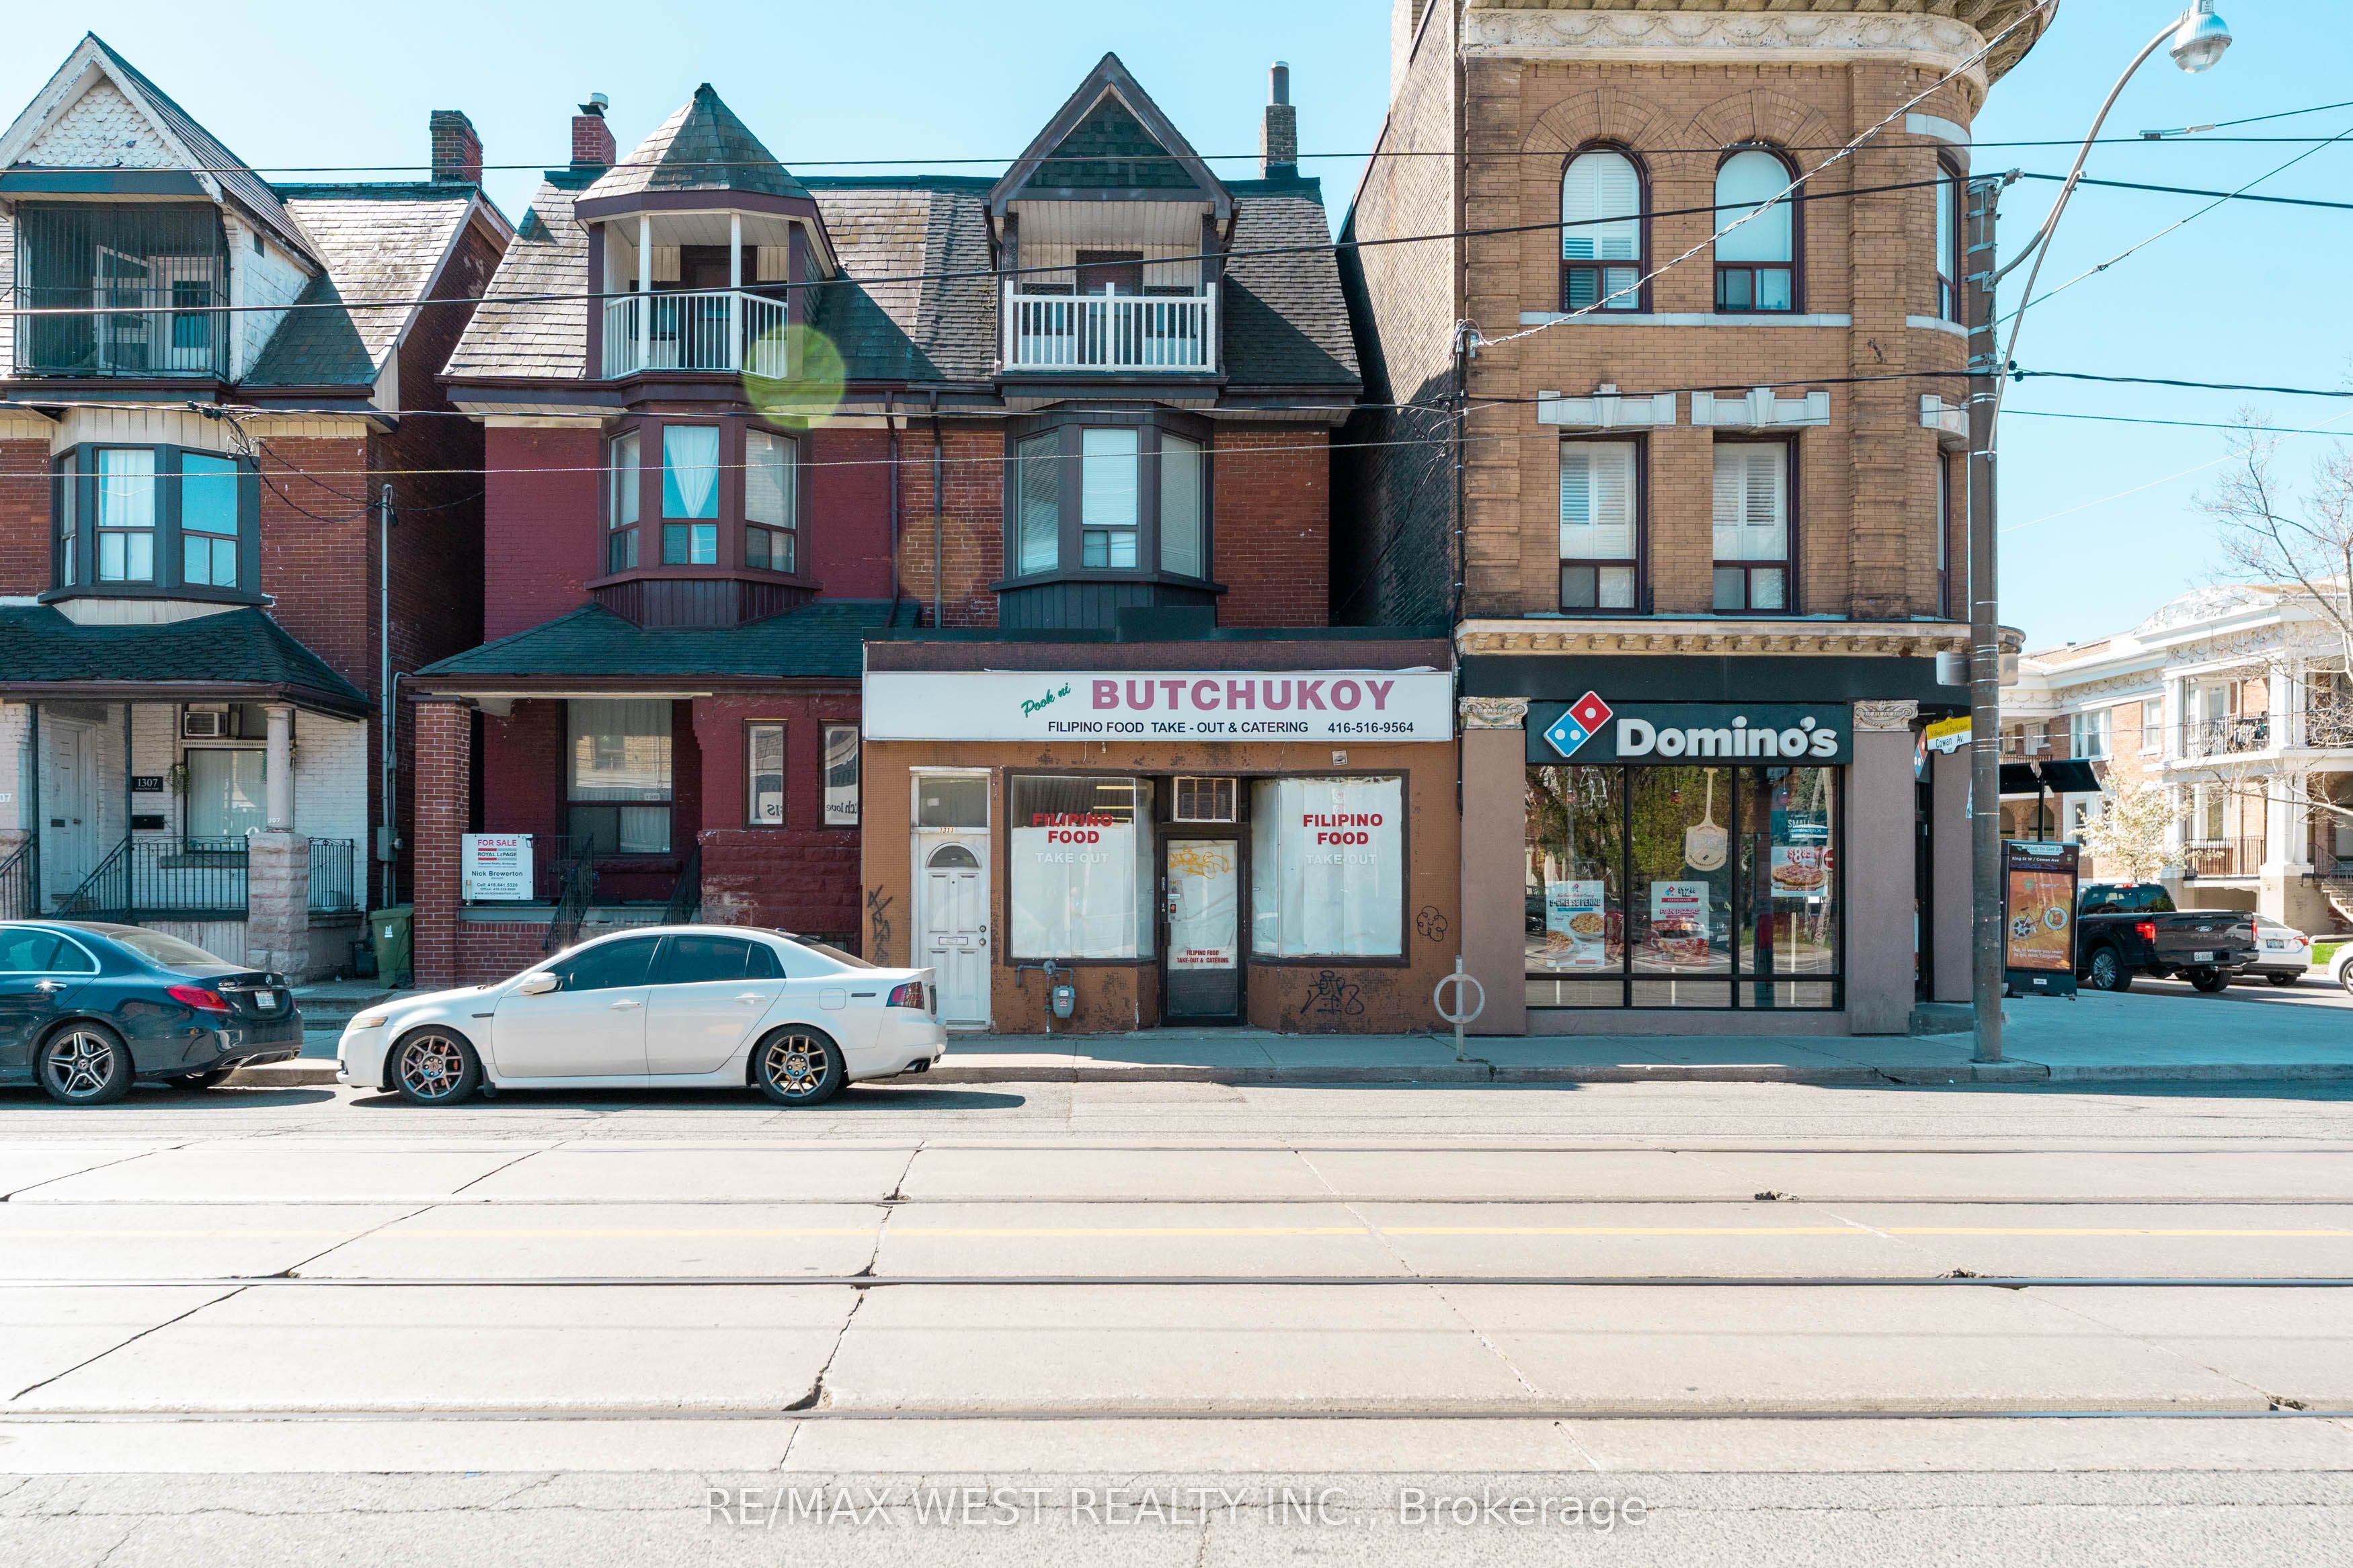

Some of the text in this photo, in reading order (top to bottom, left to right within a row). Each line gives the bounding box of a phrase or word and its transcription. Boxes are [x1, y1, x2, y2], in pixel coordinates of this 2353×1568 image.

[1092, 679, 1395, 711] BUTCHUKOY
[1021, 688, 1055, 718] Pook
[1048, 721, 1103, 733] FILIPINO
[1107, 721, 1144, 733] FOOD
[1151, 722, 1185, 733] TAKE
[1197, 722, 1225, 733] OUT
[1228, 722, 1238, 733] &
[1241, 721, 1308, 733] CATERING
[1328, 721, 1414, 734] 416-516-9564
[1616, 715, 1839, 757] Domino's
[1936, 737, 1952, 748] Cowan
[138, 778, 159, 787] 1307
[1032, 813, 1113, 827] FILIPINO
[1302, 813, 1383, 828] FILIPINO
[1047, 830, 1100, 844] FOOD
[1317, 831, 1369, 845] FOOD
[1035, 852, 1110, 864] TAKE OUT
[1306, 854, 1378, 866] TAKE OUT
